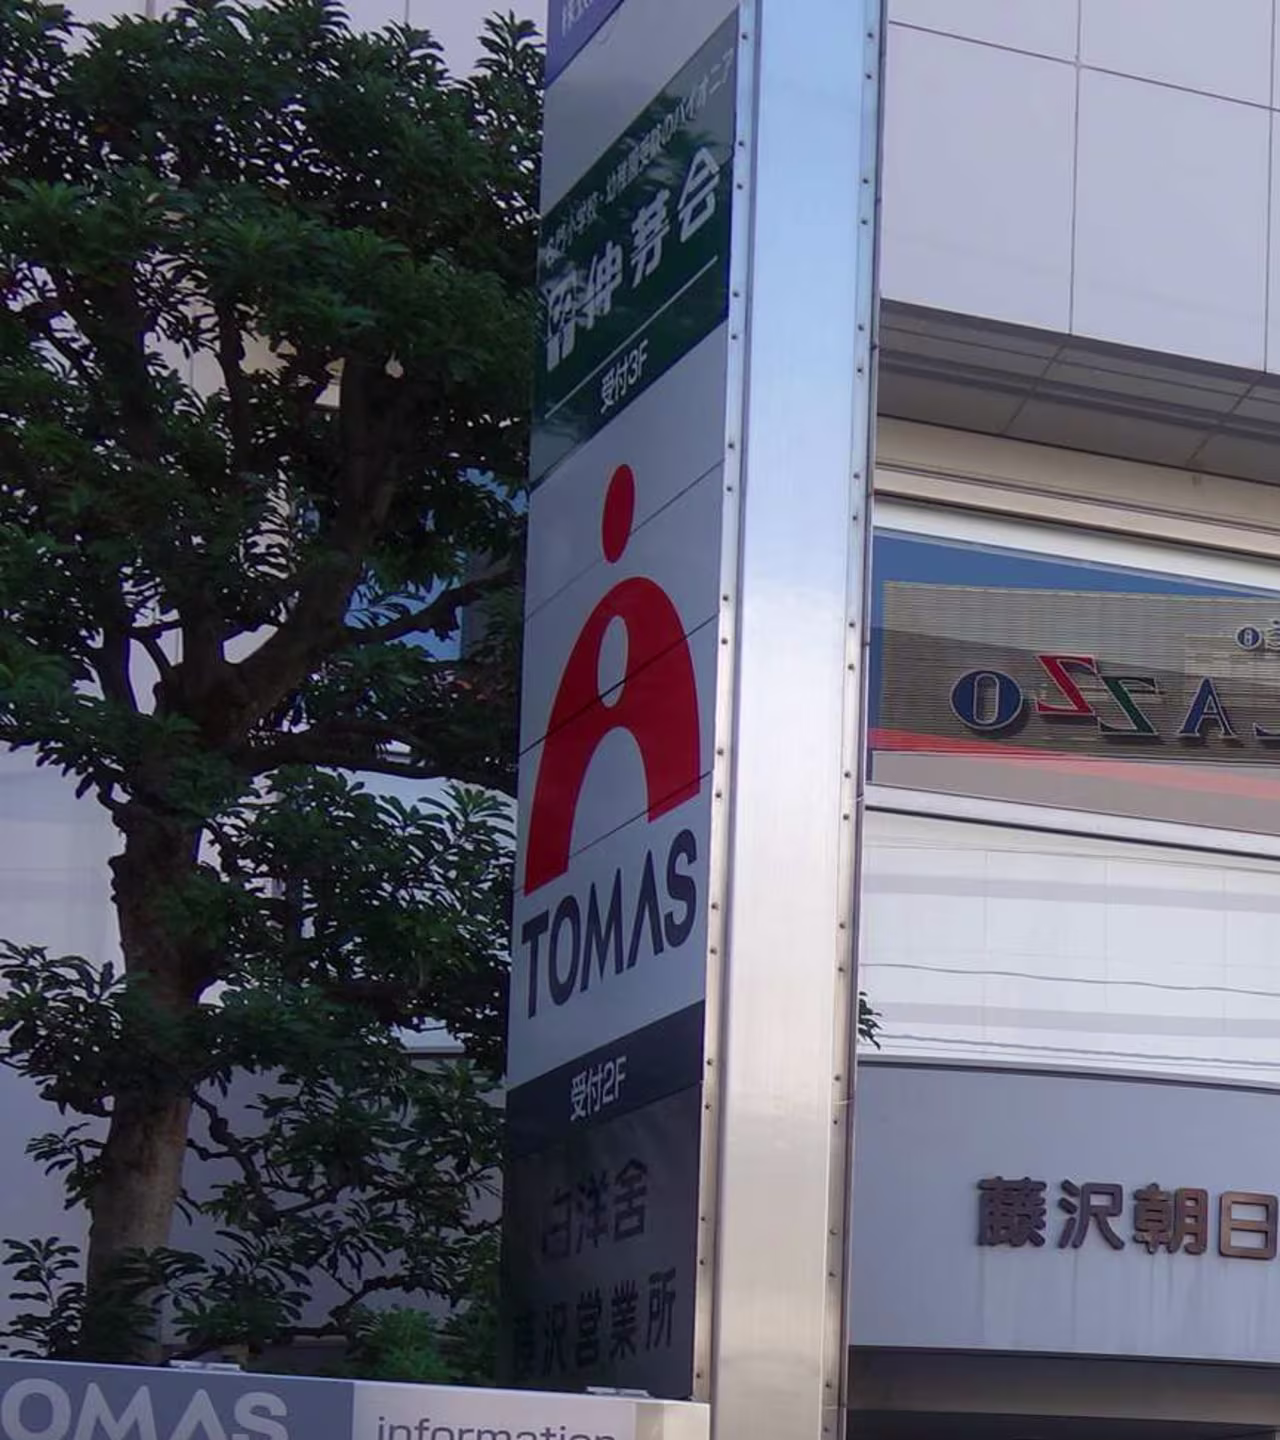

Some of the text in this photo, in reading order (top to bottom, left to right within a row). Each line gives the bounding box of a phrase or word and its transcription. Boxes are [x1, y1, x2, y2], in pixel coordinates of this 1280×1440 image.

[600, 339, 648, 414] 受付3F
[521, 828, 698, 1018] TOMAS
[570, 1056, 627, 1121] 受付2F
